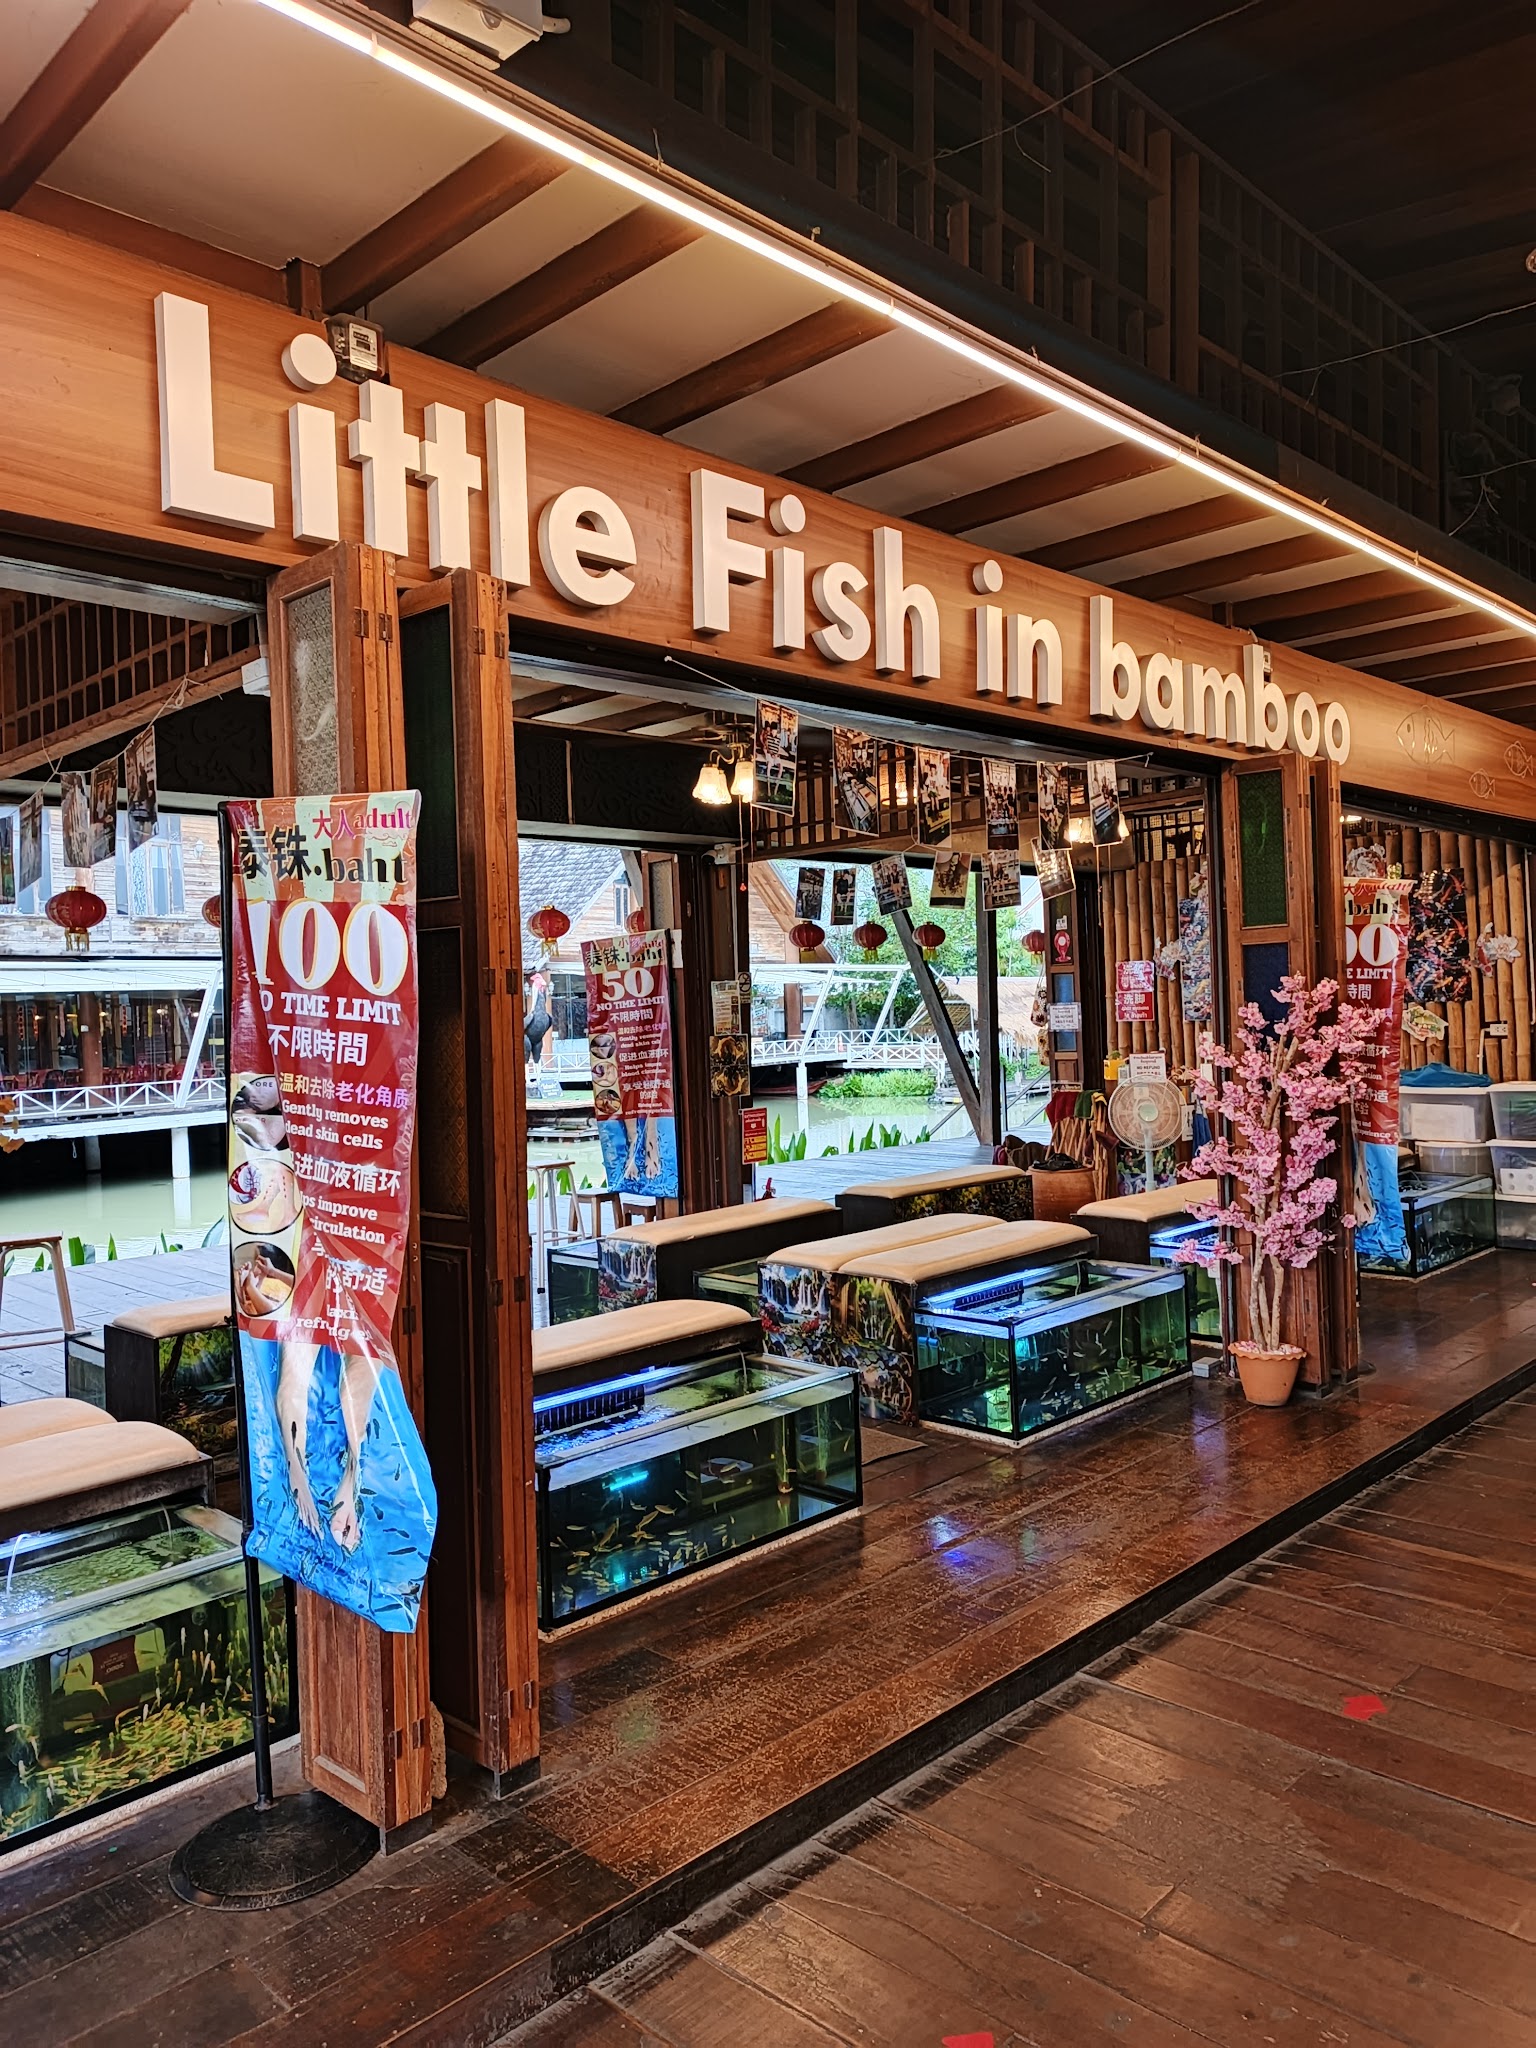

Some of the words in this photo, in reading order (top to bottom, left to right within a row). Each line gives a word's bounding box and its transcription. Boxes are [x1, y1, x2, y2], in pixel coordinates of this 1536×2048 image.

[154, 291, 637, 608] Little
[691, 468, 941, 680] Fish
[972, 559, 1063, 706] in
[1089, 595, 1352, 766] bamboo
[602, 967, 655, 1001] 50
[1356, 968, 1391, 980] LIMIT
[281, 992, 330, 1018] TIME
[336, 997, 401, 1026] LIMIT
[596, 1003, 612, 1012] NO
[613, 1000, 637, 1010] TIME
[638, 996, 665, 1007] LIMIT
[610, 1009, 654, 1023] 不限時間
[267, 1024, 368, 1067] 不限時間
[279, 1072, 410, 1110] 温和去除老化角质
[282, 1100, 323, 1122] Gently
[325, 1109, 389, 1129] removes
[285, 1120, 313, 1138] dead
[315, 1126, 339, 1144] skin
[343, 1133, 383, 1150] cells
[290, 1151, 401, 1197] 进血液循环
[317, 1196, 378, 1221] improve
